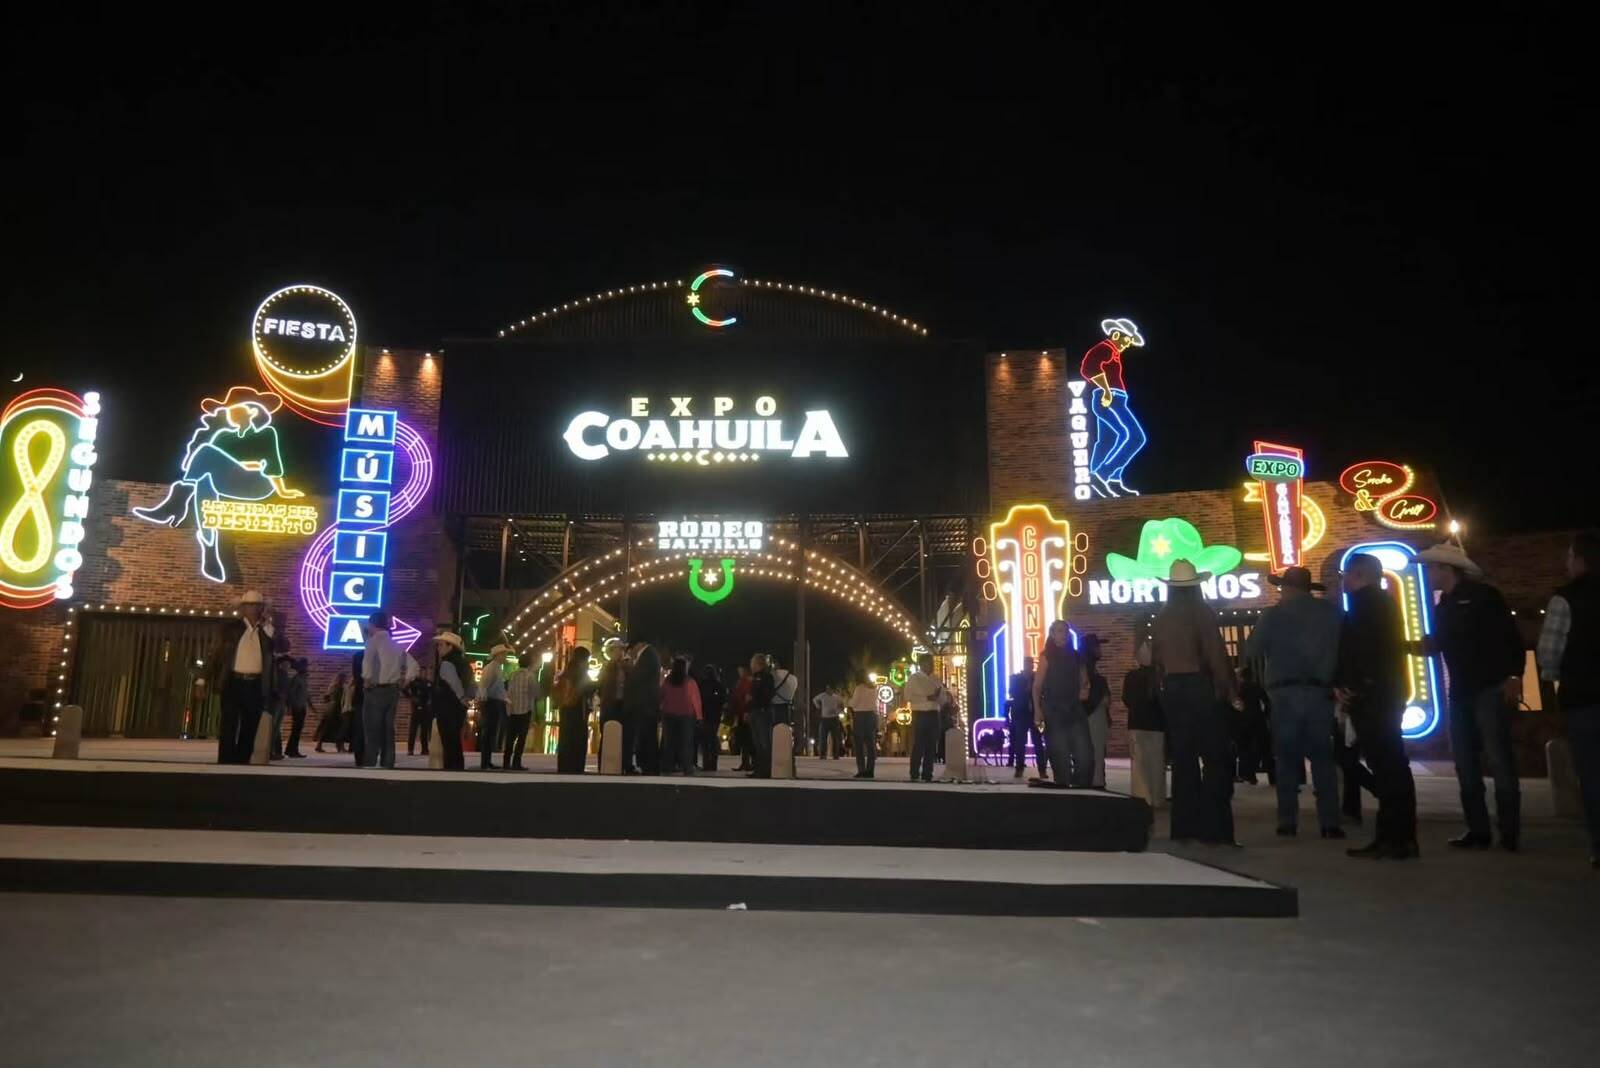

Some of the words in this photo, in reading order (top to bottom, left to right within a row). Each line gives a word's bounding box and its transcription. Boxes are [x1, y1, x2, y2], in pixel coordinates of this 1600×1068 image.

[263, 318, 346, 342] FIESTA
[630, 396, 777, 417] EXPO
[562, 410, 850, 460] COAHUILA
[1067, 381, 1091, 500] VAQUERO
[1252, 459, 1299, 477] EXPO
[1353, 469, 1393, 488] Smoke
[54, 391, 101, 600] SEGUNDOS
[201, 499, 286, 517] LEYENDAS
[287, 504, 319, 519] DEL
[1389, 499, 1425, 520] Grill
[202, 511, 318, 536] DESIERTO
[340, 414, 387, 644] MÚSICA
[658, 520, 763, 538] RODEO
[658, 539, 762, 550] SALTILLO
